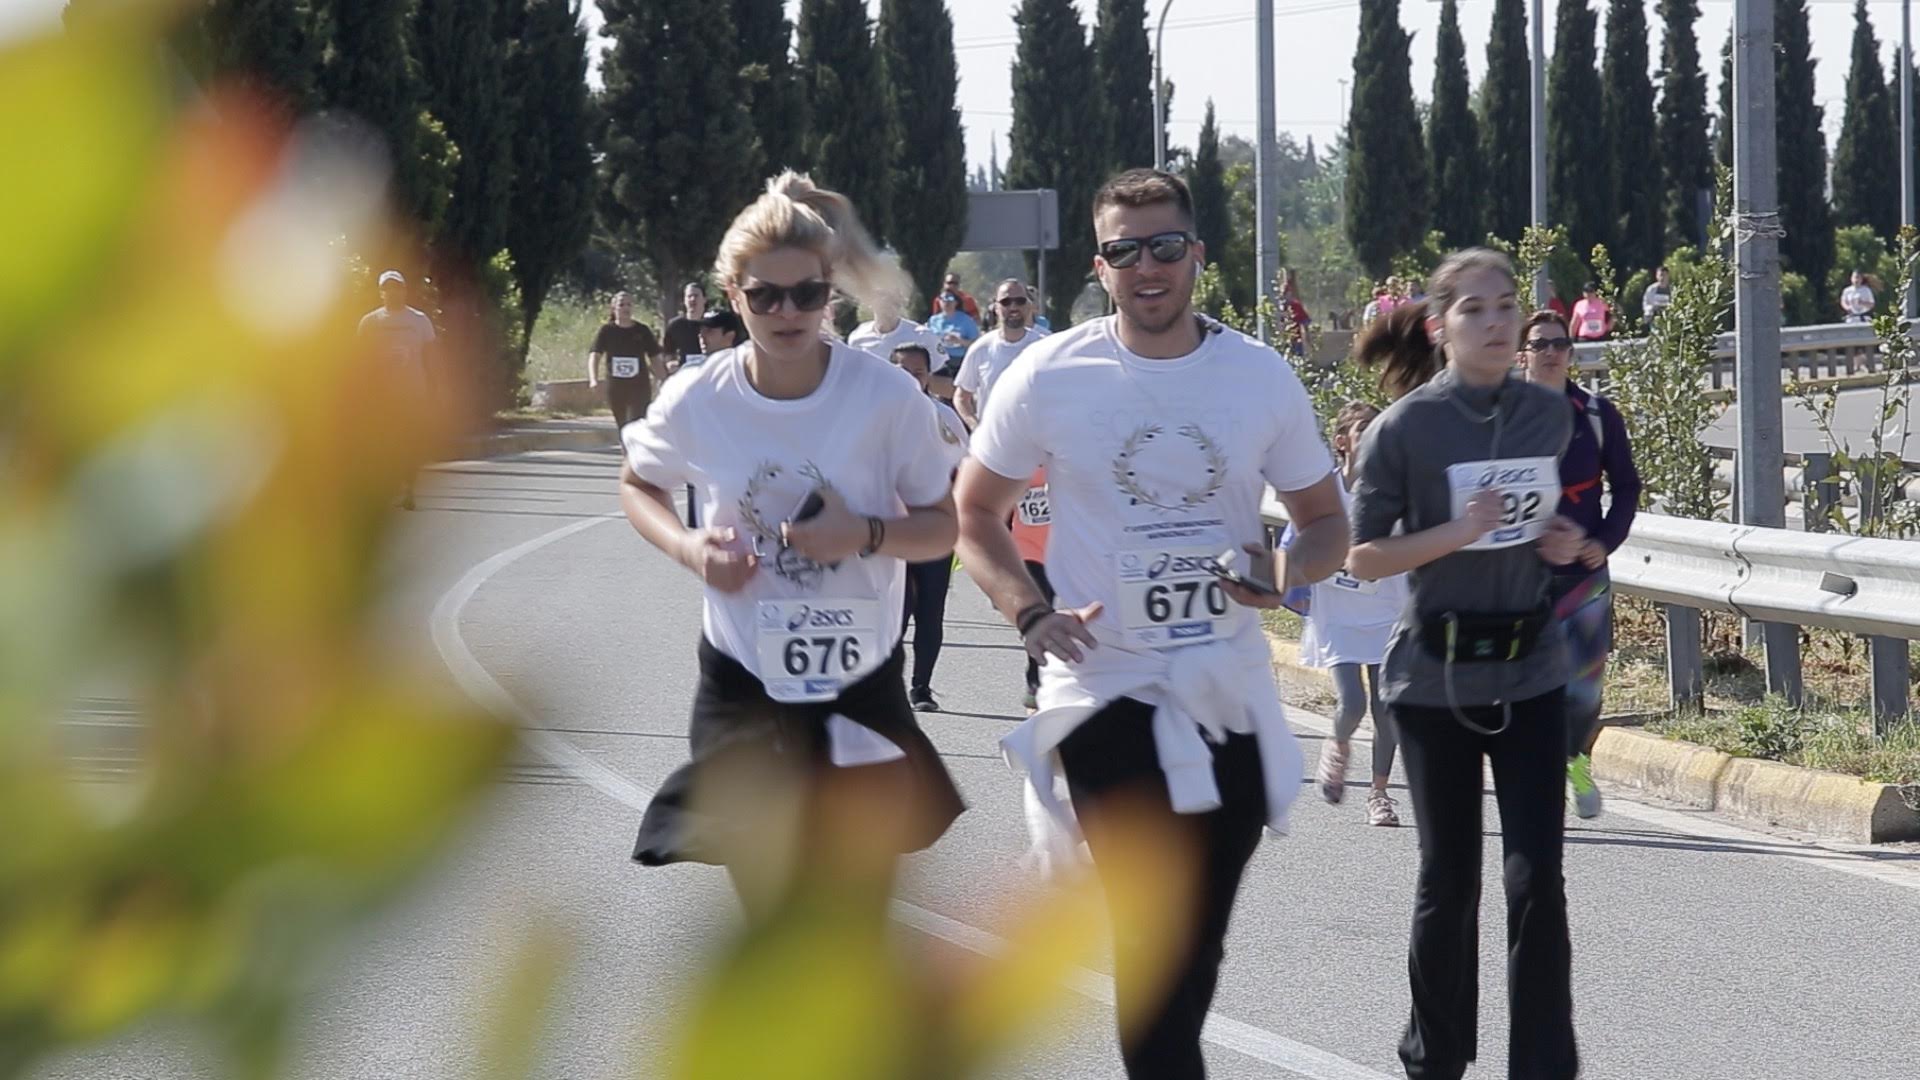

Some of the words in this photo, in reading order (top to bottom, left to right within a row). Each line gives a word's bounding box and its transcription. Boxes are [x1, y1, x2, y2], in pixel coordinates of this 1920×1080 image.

[1020, 501, 1050, 516] 162
[1501, 492, 1541, 524] 92
[810, 608, 853, 627] asics
[1145, 581, 1226, 623] 670
[784, 636, 860, 675] 676
